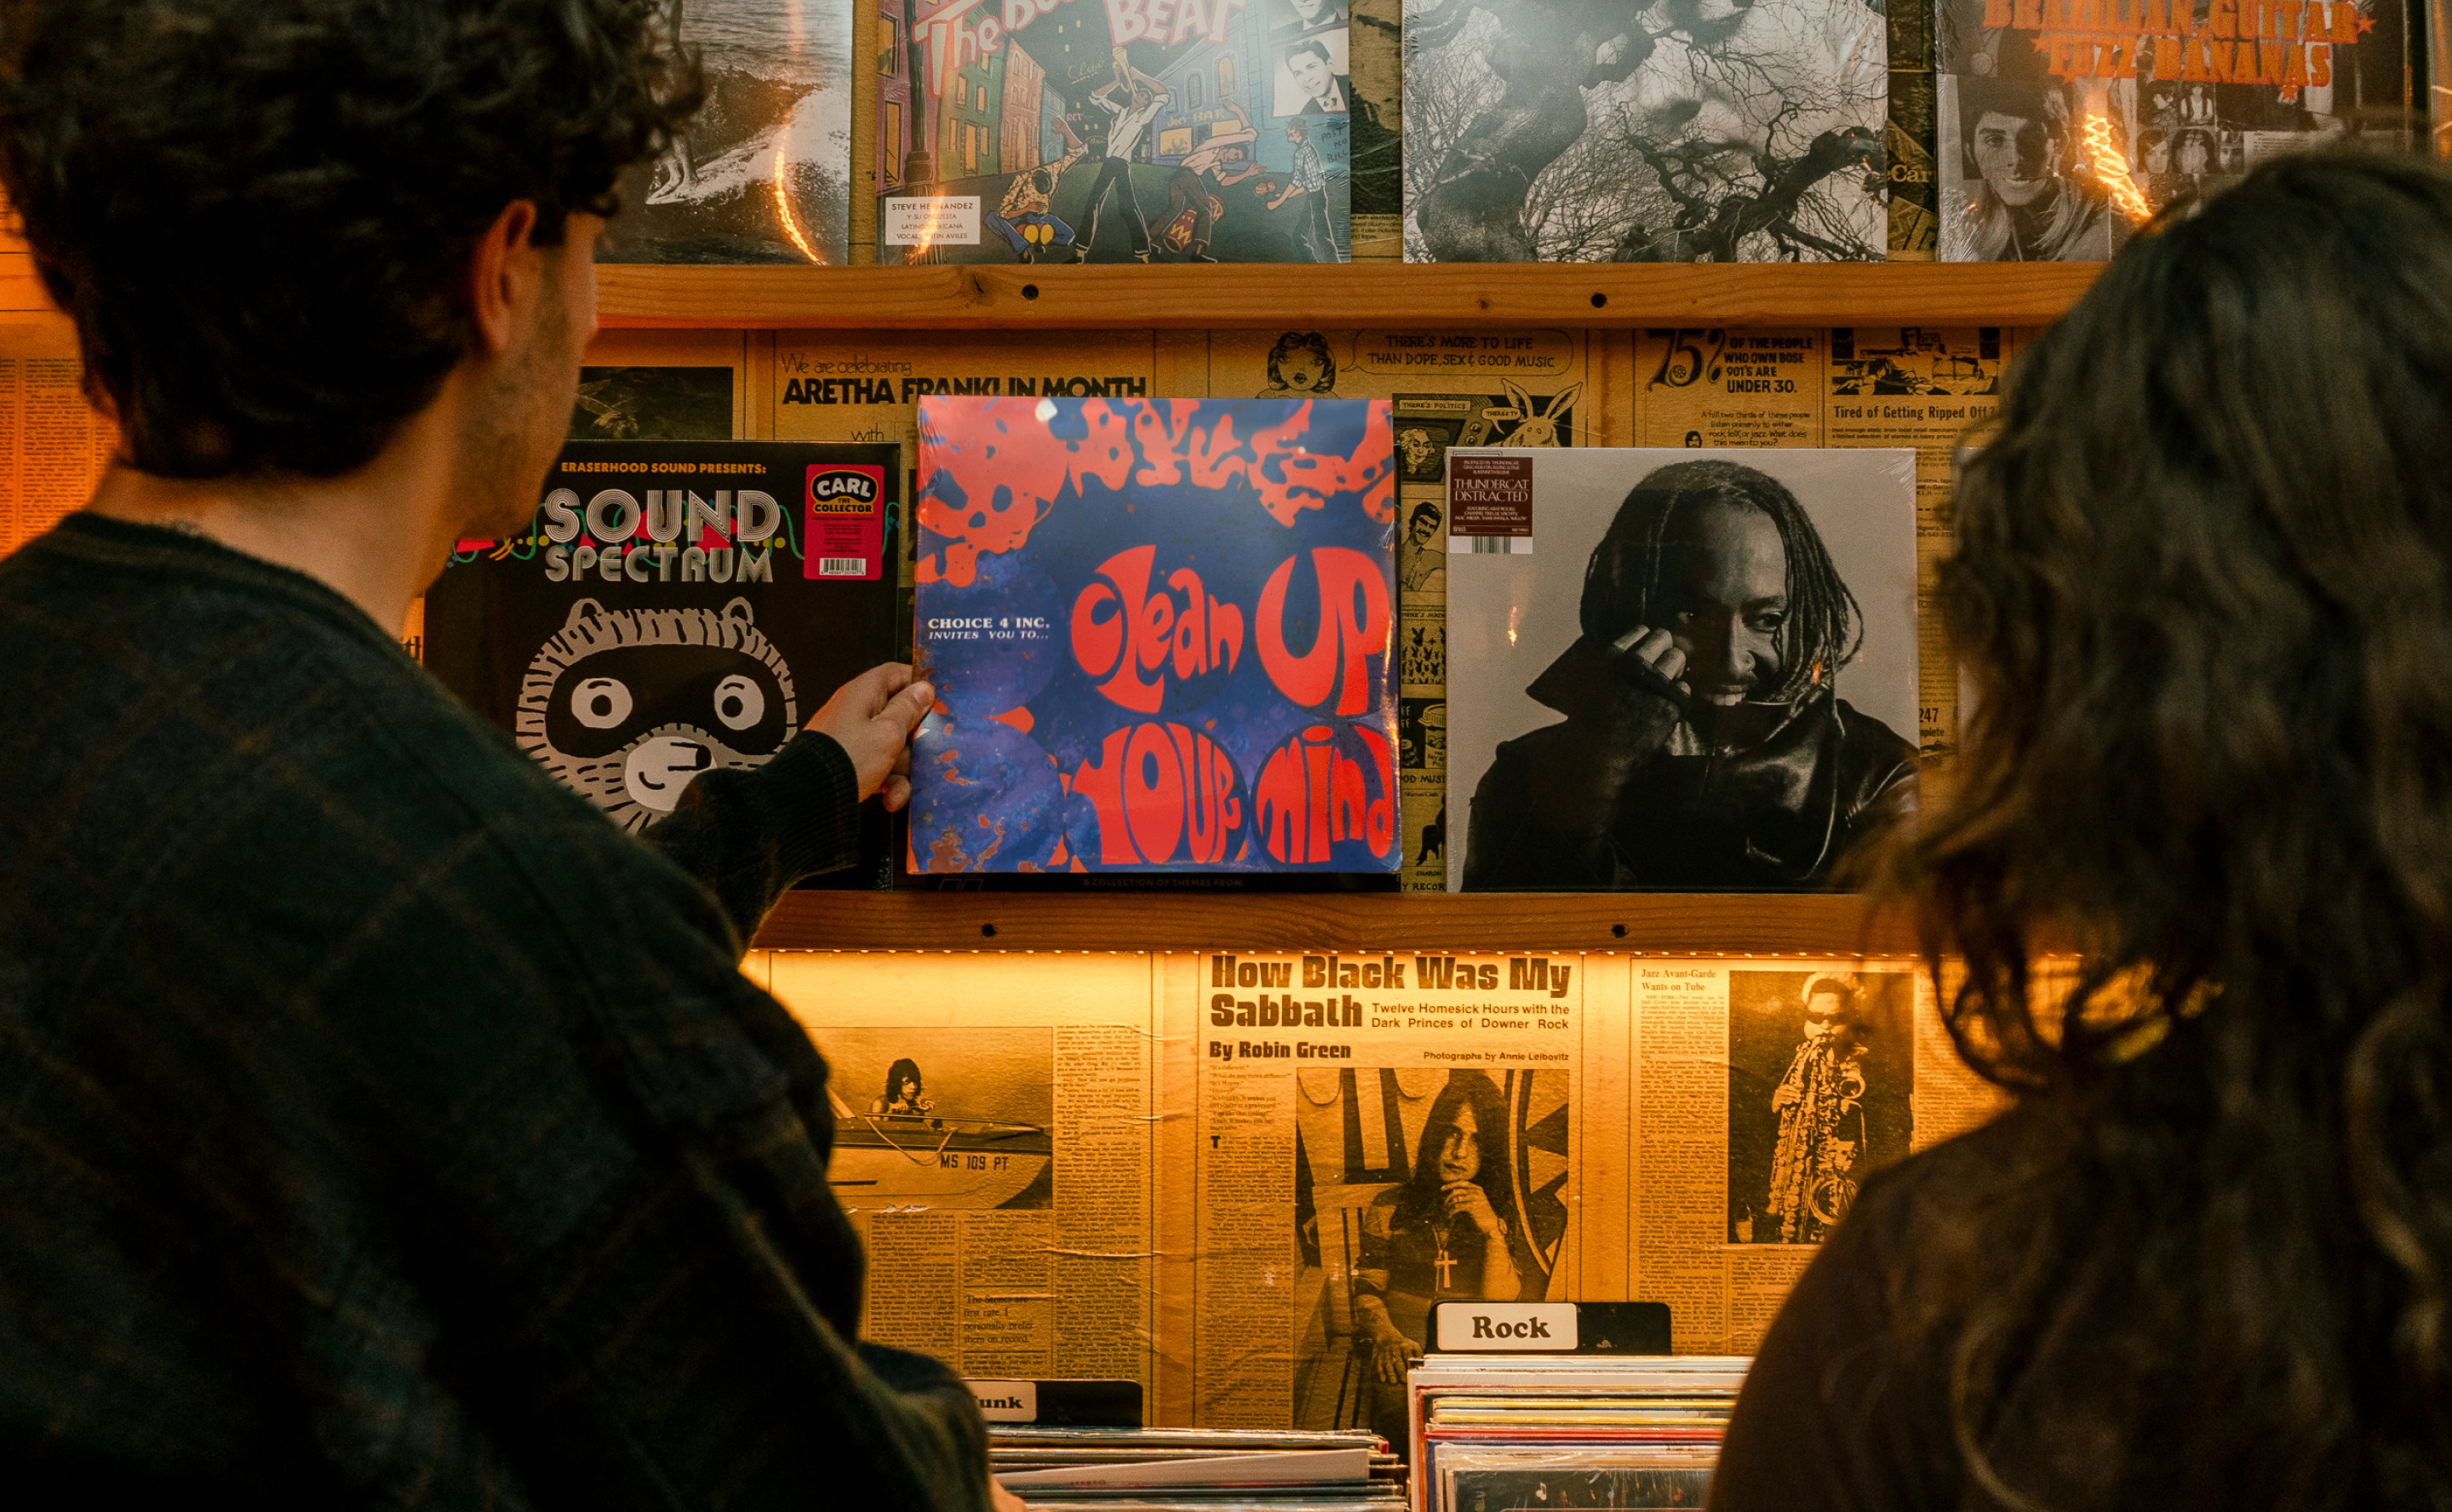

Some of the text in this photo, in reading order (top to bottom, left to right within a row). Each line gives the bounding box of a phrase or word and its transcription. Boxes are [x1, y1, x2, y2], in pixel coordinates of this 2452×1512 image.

[1106, 0, 1247, 46] BEAT
[1983, 0, 2358, 43] BRAZILIAN GUITAR
[911, 0, 1003, 99] The
[2048, 33, 2331, 88] FUZZ BANANAS
[1321, 129, 1343, 143] POST
[1386, 335, 1533, 350] THERE'S MORE TO LIFE
[1729, 337, 1813, 349] OF THE PEOPLE
[781, 352, 913, 376] We are celebrating
[1367, 352, 1402, 364] THAN
[1478, 355, 1511, 367] GOOD
[1723, 352, 1804, 364] WHO OWN BOSE
[1756, 366, 1777, 377] ARE
[782, 376, 1147, 404] ARETHA FRANKLIN MONTH
[1727, 379, 1797, 393] UNDER 30.
[1789, 411, 1810, 421] people
[1834, 405, 1996, 421] Tired of Getting Ripped Off?
[850, 422, 885, 441] with
[1760, 438, 1779, 448] you?
[561, 461, 767, 474] ERASERHOOD SOUND PRESENTS:
[817, 478, 871, 497] CARL
[1453, 478, 1530, 490] THUNDERCAT
[1455, 490, 1528, 502] DISTRACTED
[814, 504, 873, 513] COLLECTOR
[544, 488, 782, 543] SOUND
[544, 545, 774, 583] SPECTRUM
[927, 617, 1050, 629] CHOICE 4 INC.
[928, 630, 1049, 639] INVITES YOU TO...
[1420, 775, 1446, 783] MUSI
[1092, 878, 1154, 887] COLLECTION
[1156, 878, 1171, 887] OF
[1172, 878, 1212, 887] THEMES
[1213, 878, 1243, 887] FROM
[1412, 882, 1446, 891] RECOR
[1212, 955, 1572, 999] How Black Was My
[1641, 969, 1716, 978] Jazz Avant-Garde
[1641, 982, 1669, 991] Wants
[1684, 982, 1706, 991] Tube
[1211, 994, 1362, 1027] Sabbath
[1372, 1003, 1570, 1015] Twelve Homesick Hours with the
[1372, 1017, 1569, 1029] Dark Princes of Downer Rock
[1209, 1040, 1351, 1062] By Robin Green
[1424, 1051, 1569, 1062] Photographs by Annie Leibovitz
[940, 1154, 1009, 1171] MS 109 PT
[984, 1295, 1012, 1303] Stones
[963, 1309, 980, 1317] first
[963, 1321, 1033, 1331] personally prefer
[1471, 1315, 1551, 1339] Rock
[978, 1395, 1023, 1409] unk
